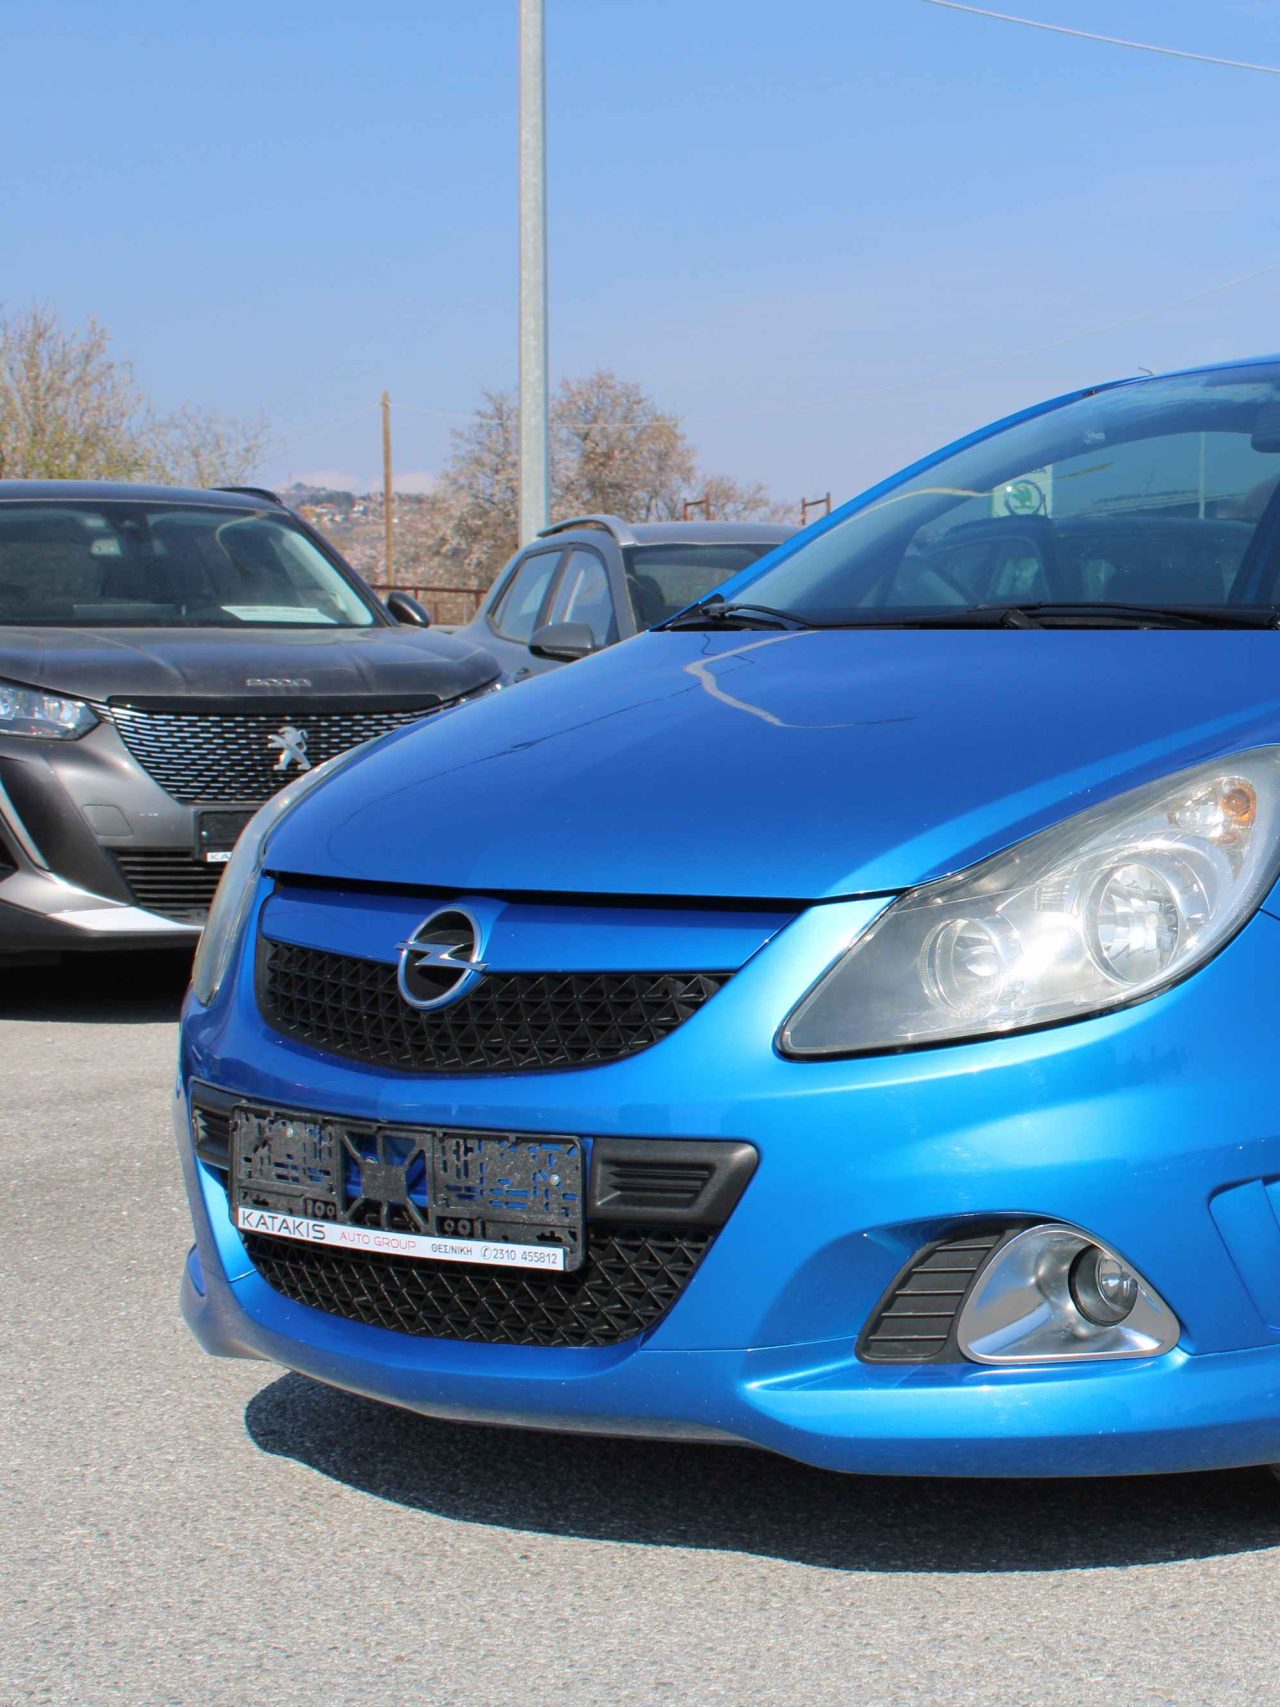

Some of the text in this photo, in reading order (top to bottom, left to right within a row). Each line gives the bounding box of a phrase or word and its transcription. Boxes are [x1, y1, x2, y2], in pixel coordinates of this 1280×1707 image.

[242, 1210, 417, 1251] KATAKIS AUTO GROUP
[431, 1243, 558, 1264] ΘΕΣ/ΝΙΚΗ 2310 455812
